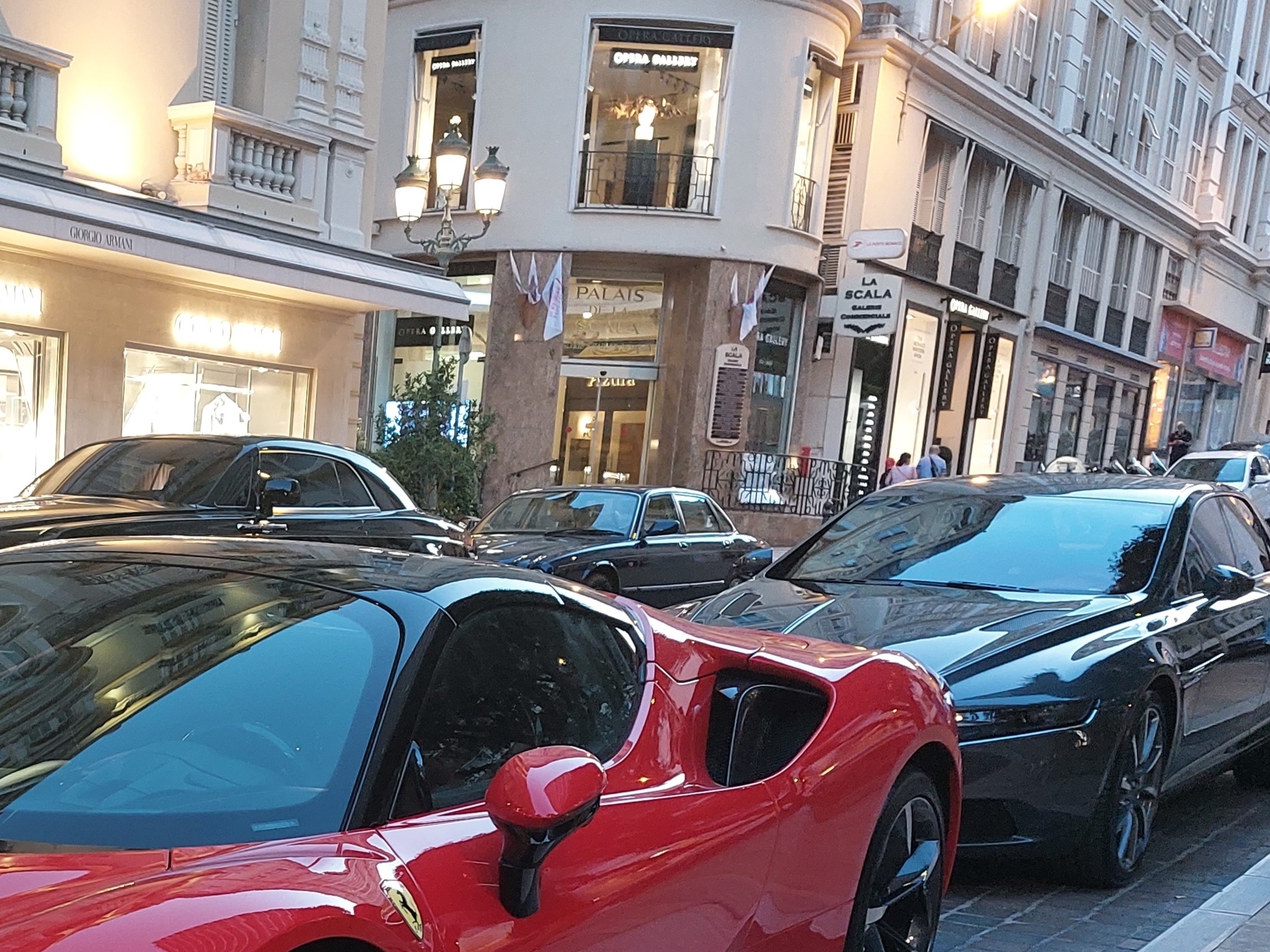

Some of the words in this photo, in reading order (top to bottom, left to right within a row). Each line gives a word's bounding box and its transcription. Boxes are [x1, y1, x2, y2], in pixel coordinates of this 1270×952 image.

[614, 51, 650, 65] OPERA
[651, 54, 698, 68] GALLERY
[70, 225, 102, 244] GIORGIO
[105, 233, 133, 251] ARMANI
[861, 277, 877, 287] LA
[576, 286, 645, 302] PALAIS
[845, 289, 892, 300] SCALA
[950, 297, 968, 314] OPERA
[968, 303, 990, 321] GALLERY
[398, 326, 427, 337] OPERA
[947, 323, 958, 358] OPERA
[986, 336, 996, 370] OPERA
[941, 361, 952, 407] GALLERY
